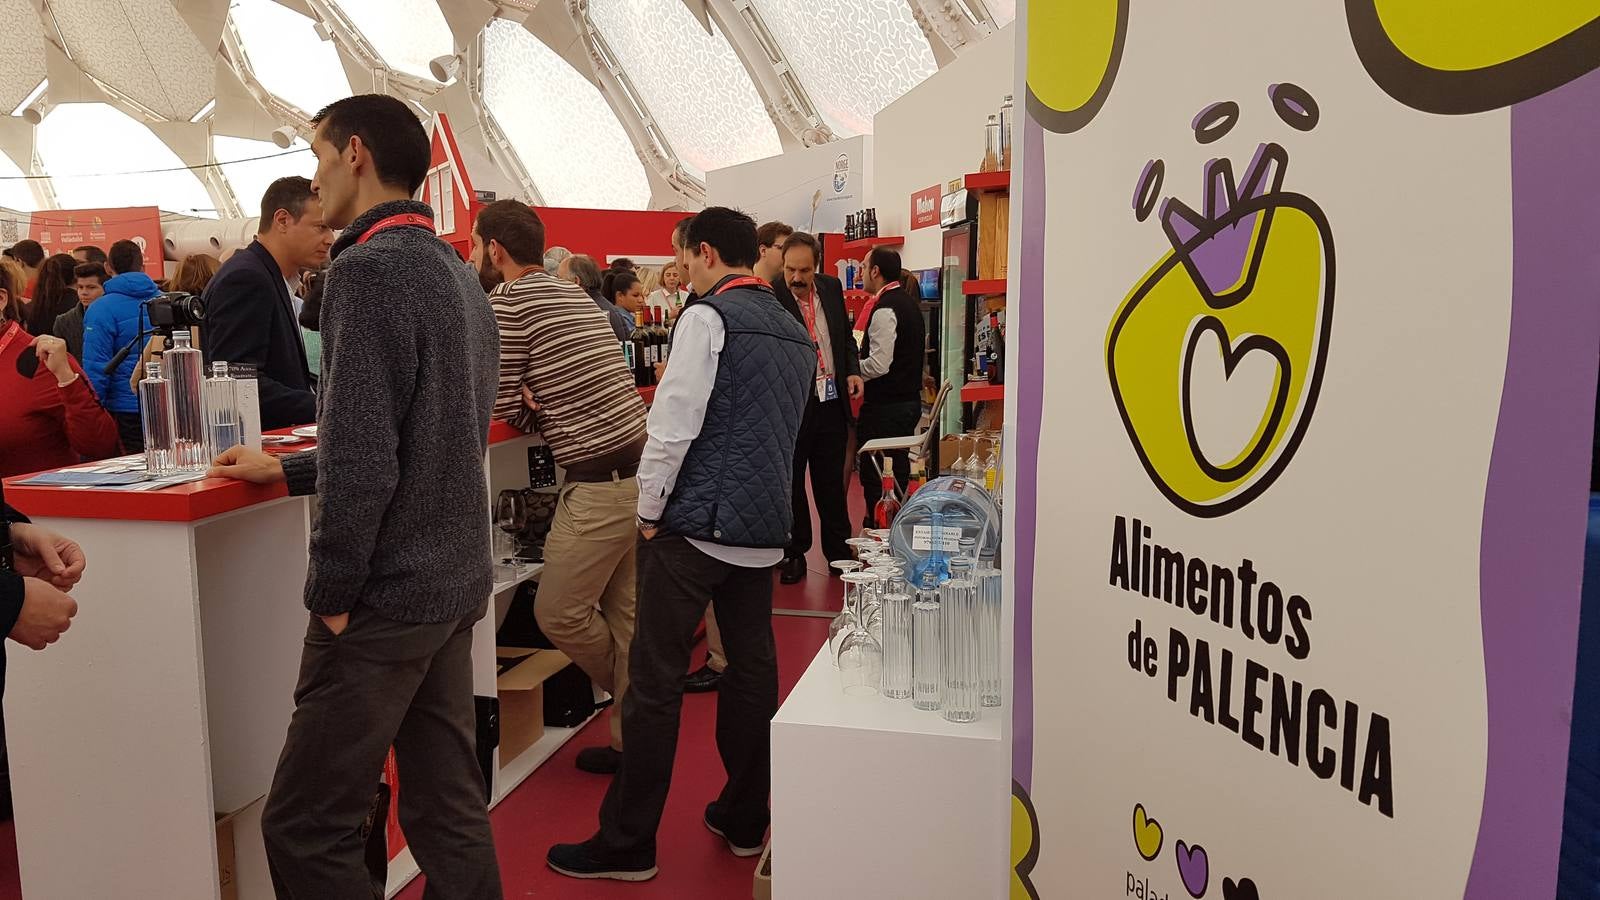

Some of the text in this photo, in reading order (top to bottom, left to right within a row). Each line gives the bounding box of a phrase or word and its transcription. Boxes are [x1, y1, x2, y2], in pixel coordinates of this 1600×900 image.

[835, 159, 848, 170] NORGE
[1109, 515, 1312, 660] Alimentos
[1128, 619, 1394, 818] de PALENCIA
[1126, 871, 1169, 900] pala
